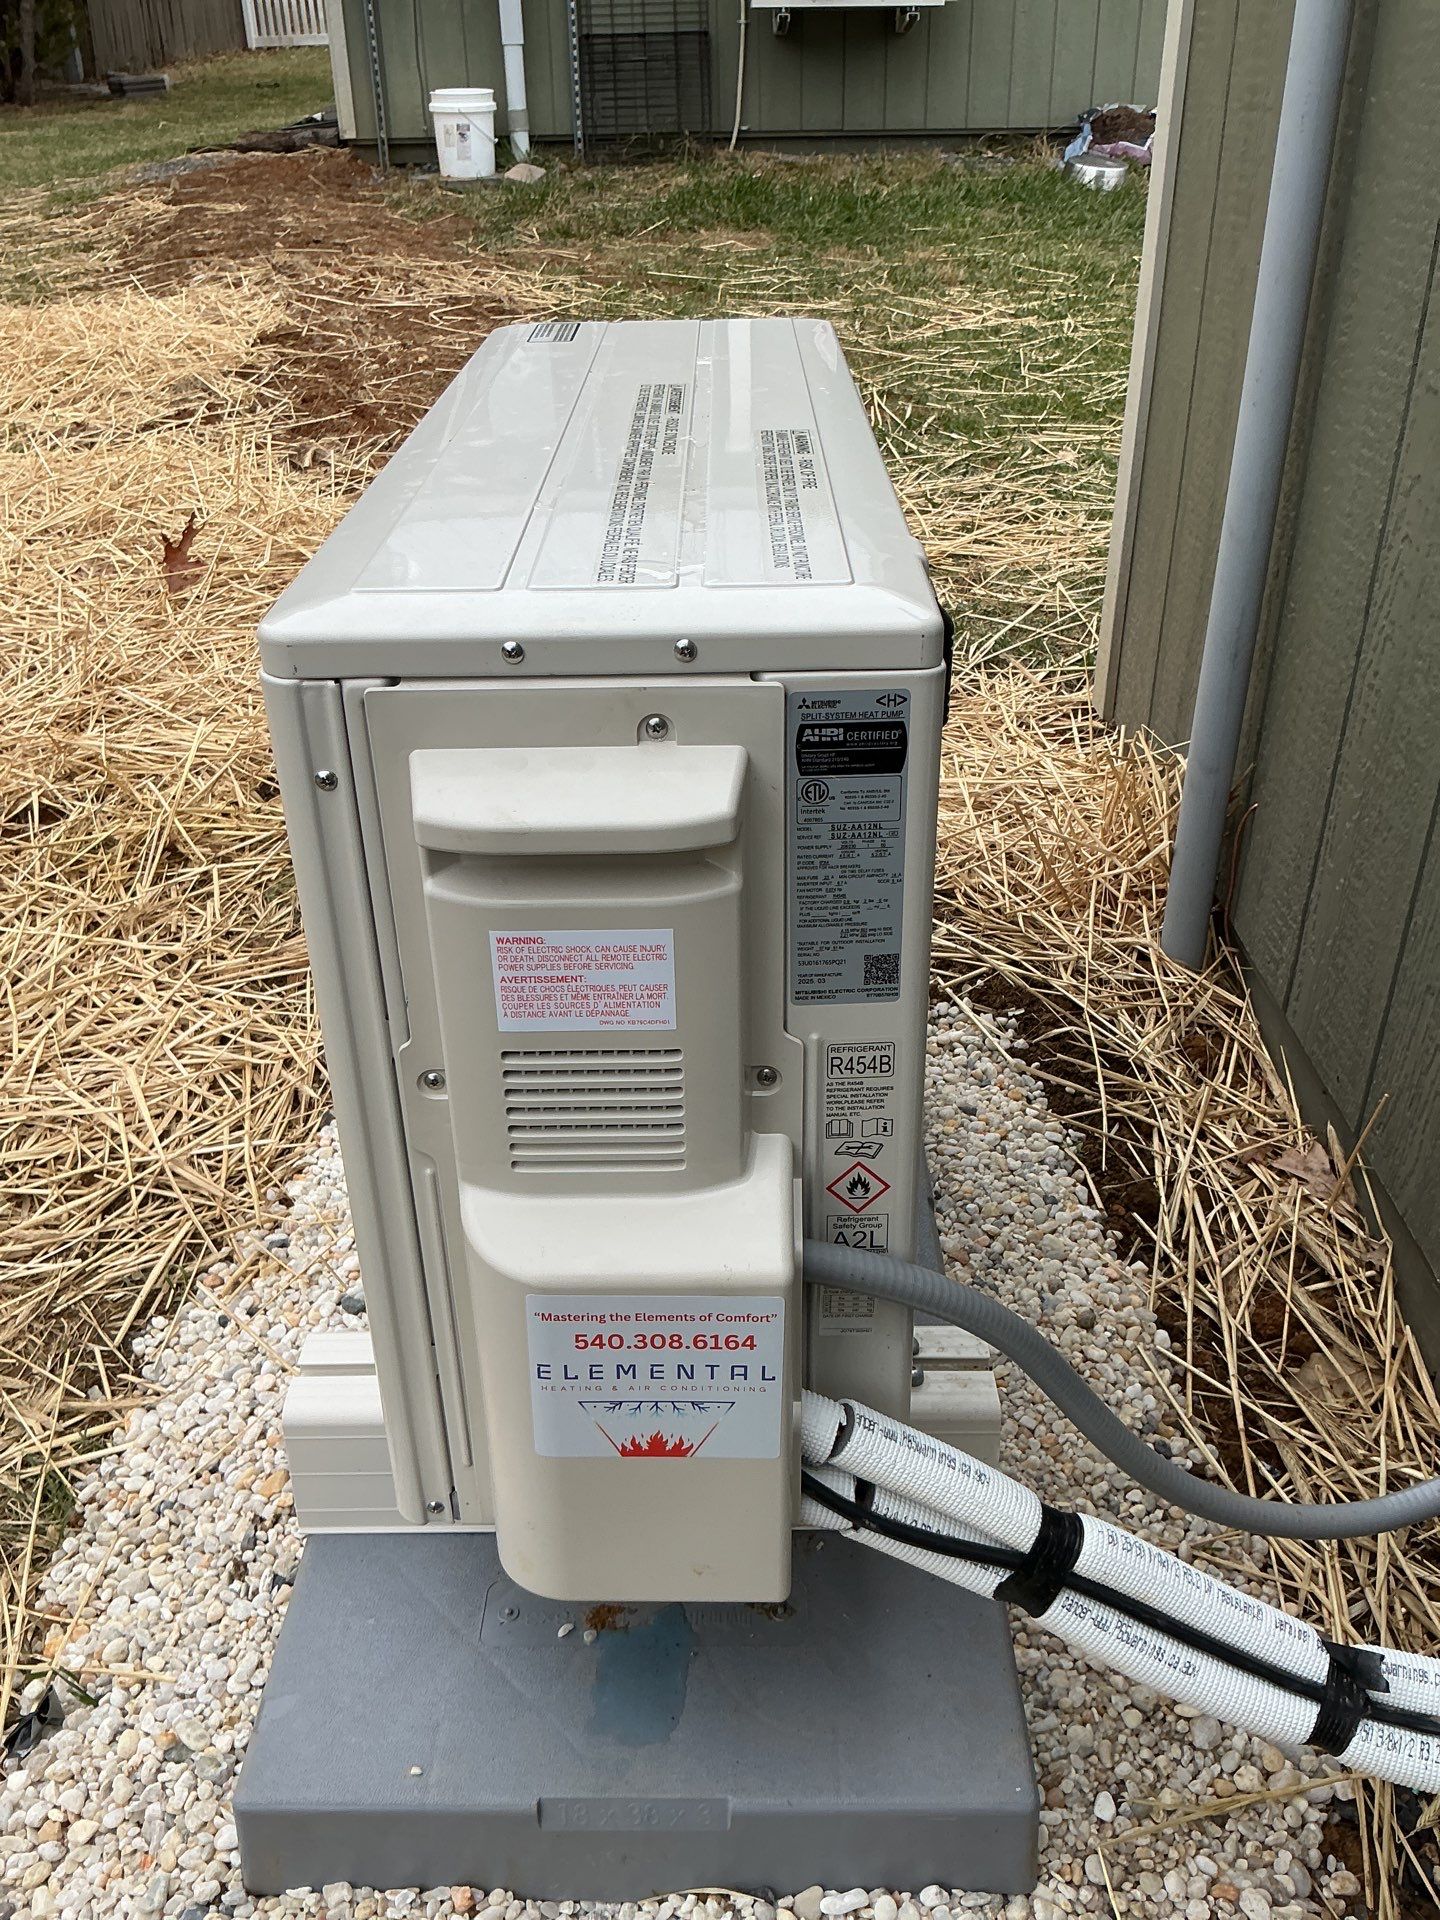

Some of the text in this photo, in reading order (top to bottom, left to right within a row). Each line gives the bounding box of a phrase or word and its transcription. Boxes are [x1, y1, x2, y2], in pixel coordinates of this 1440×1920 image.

[801, 712, 856, 720] SPLIT-SYSTEM
[802, 728, 844, 742] AHRI
[528, 946, 563, 954] ELECTRIC
[526, 963, 561, 971] SUPPLIES
[564, 963, 592, 971] BEFORE
[500, 975, 586, 984] AVERTISSEMENT:
[830, 1044, 892, 1053] REFRIGERANT
[830, 1055, 892, 1075] R454B
[834, 1230, 884, 1249] A2L
[610, 1313, 631, 1322] the
[635, 1313, 696, 1322] Elements
[699, 1312, 713, 1322] of
[574, 1333, 757, 1351] 540.308.6164
[536, 1364, 776, 1381] ELEMENTAL
